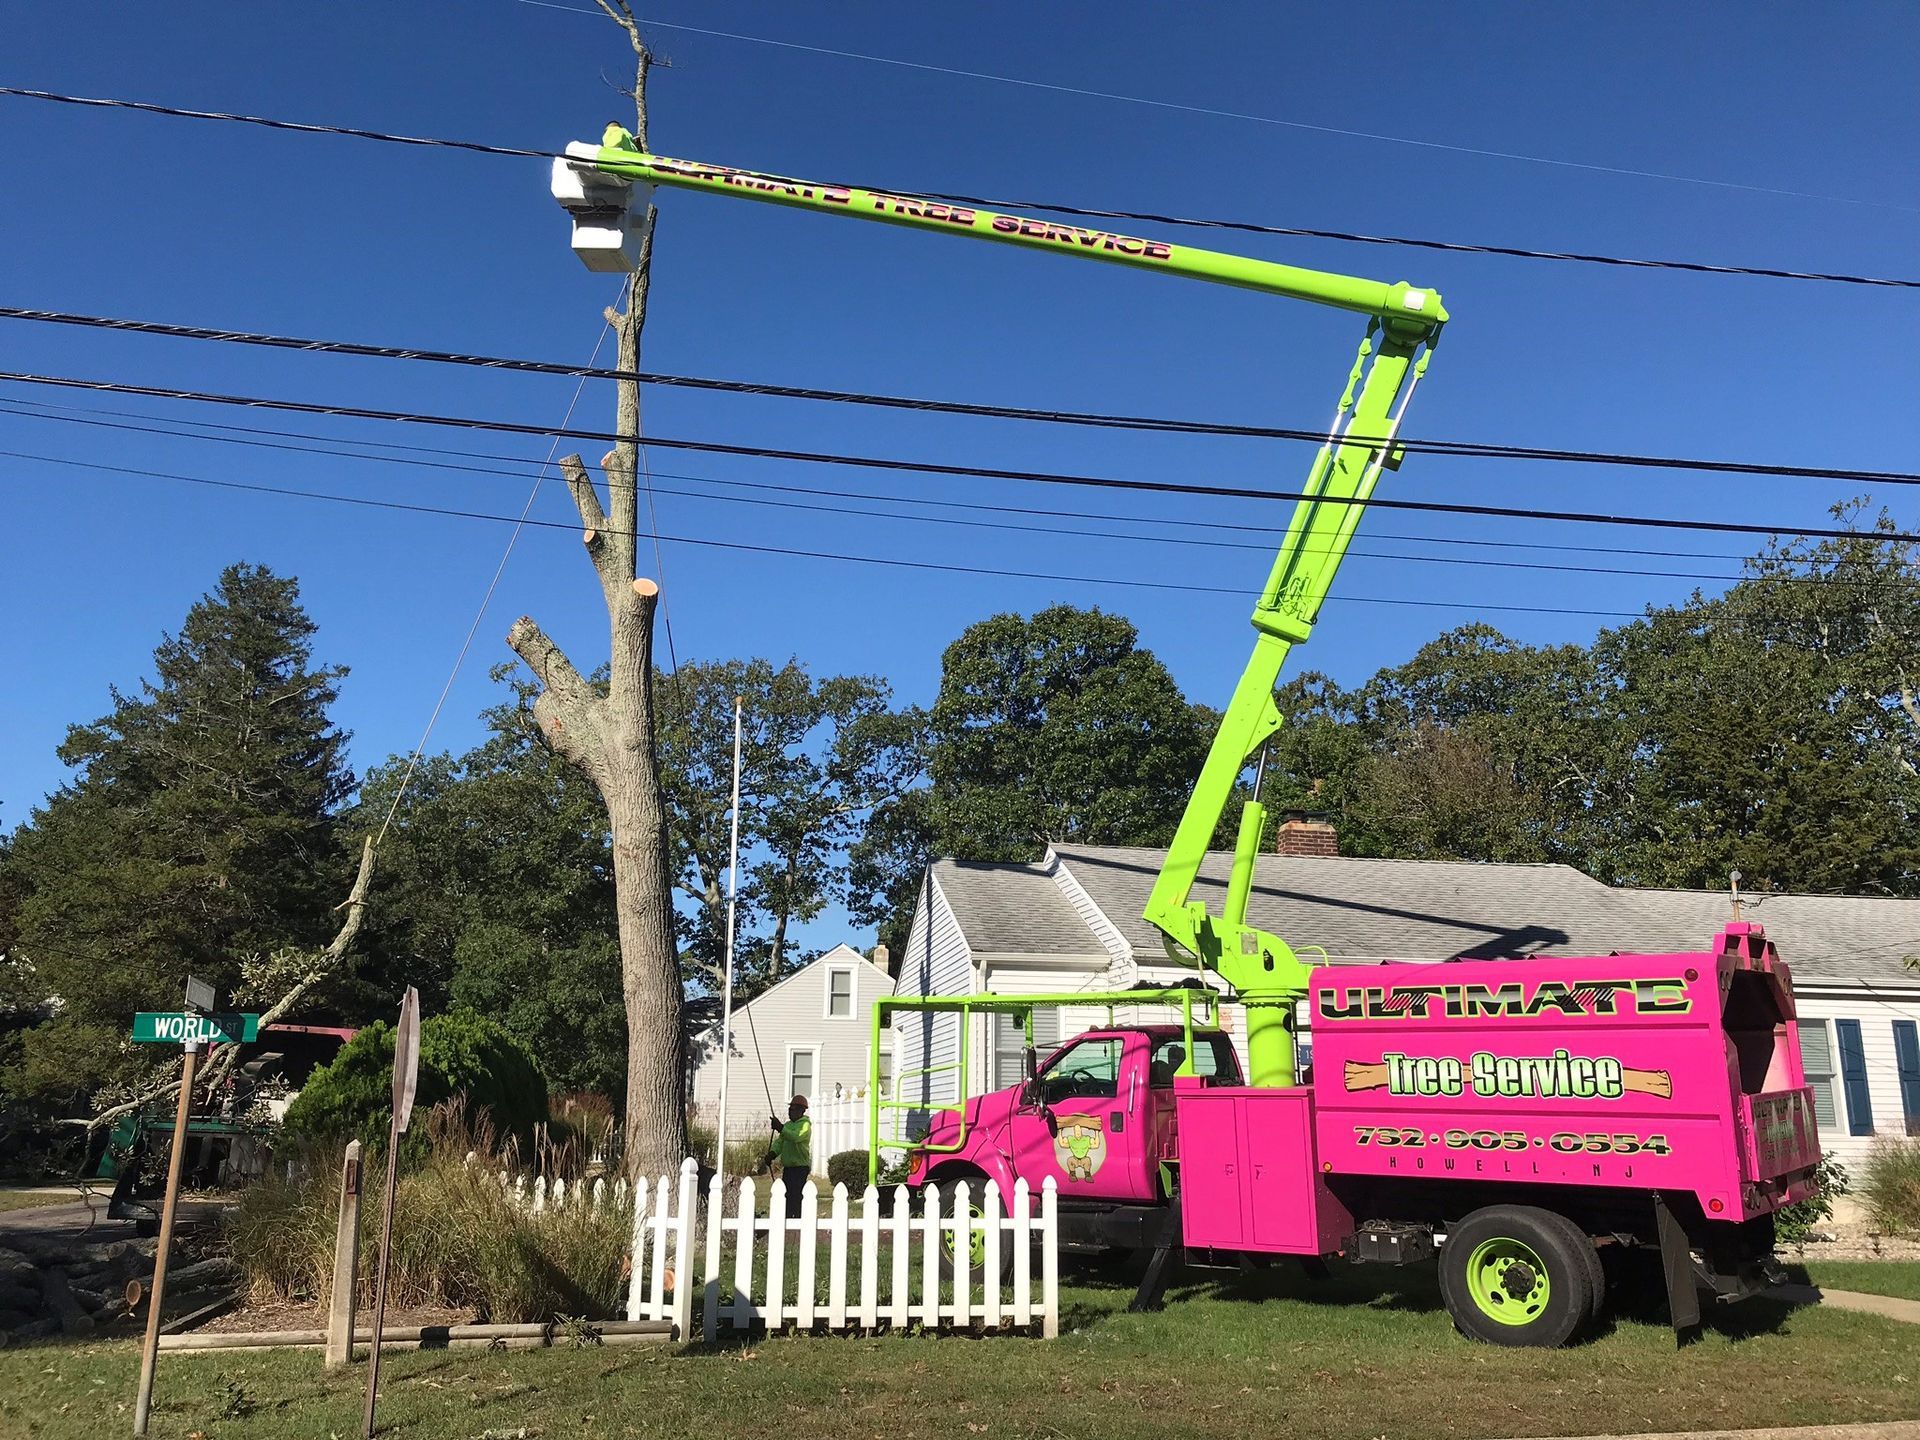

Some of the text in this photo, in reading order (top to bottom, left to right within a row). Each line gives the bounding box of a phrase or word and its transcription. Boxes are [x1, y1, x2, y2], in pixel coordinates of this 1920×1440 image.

[652, 155, 1172, 260] ULTIMATE TREE SERVICE
[1318, 978, 1693, 1021] ULTIMATE
[154, 1017, 239, 1039] WORLD ST
[1383, 1048, 1623, 1100] Tree Service
[1593, 1163, 1634, 1179] NJ
